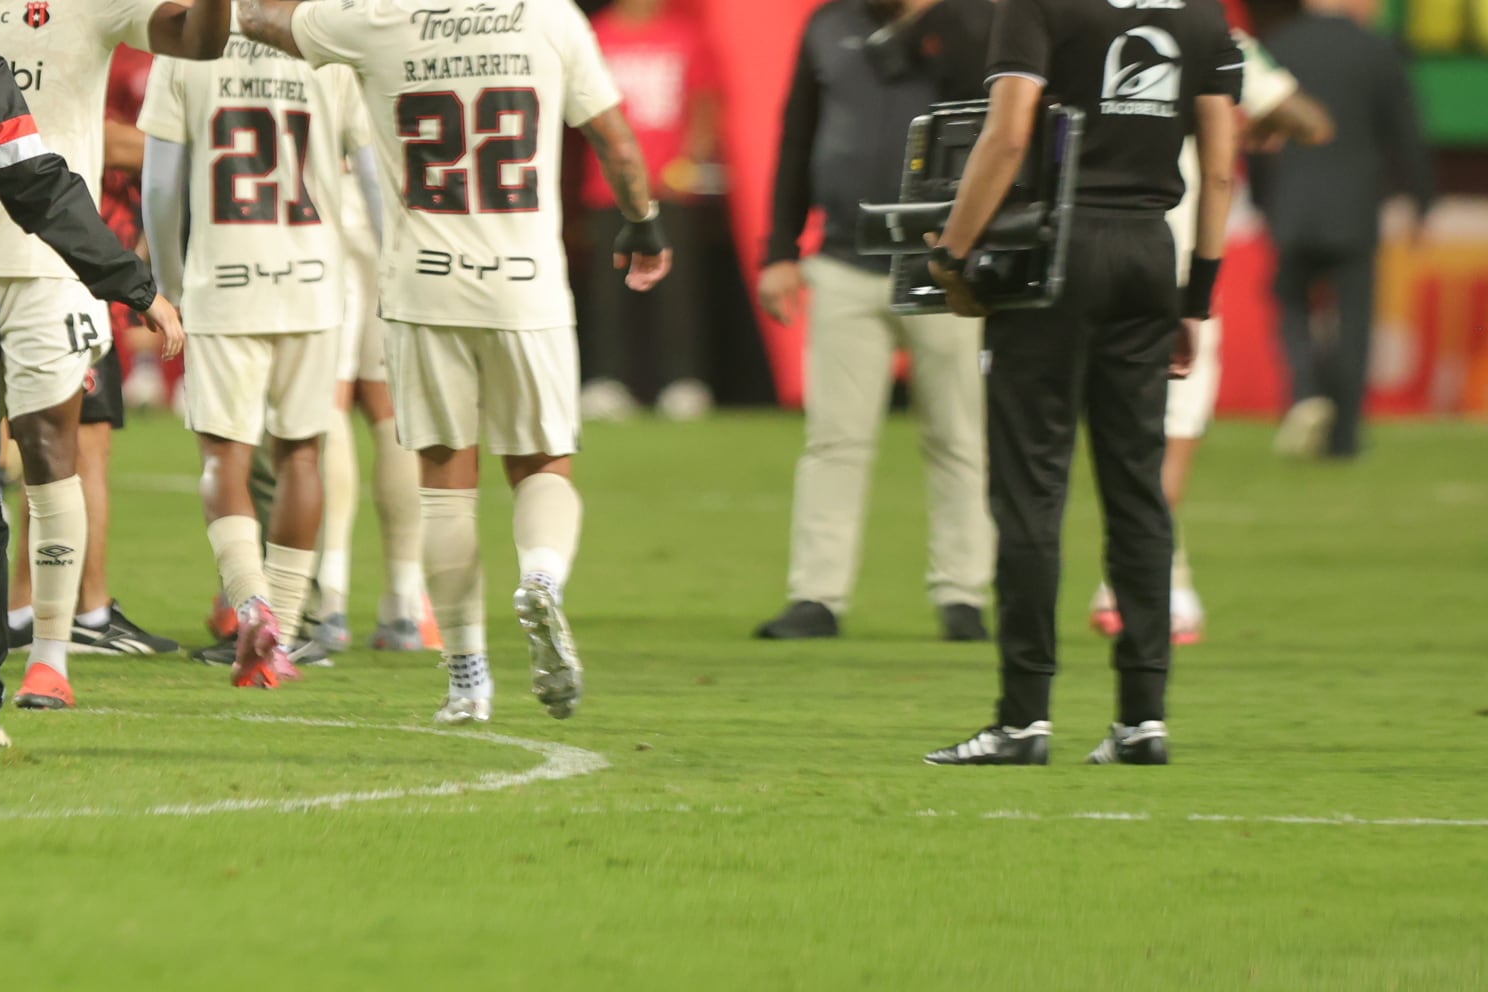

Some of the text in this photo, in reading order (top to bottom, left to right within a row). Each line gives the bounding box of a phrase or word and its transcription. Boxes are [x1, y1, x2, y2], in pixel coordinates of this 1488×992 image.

[411, 1, 525, 43] Tropical
[404, 55, 532, 82] R.MATARRITA
[218, 77, 308, 103] K.MICHEL
[396, 86, 540, 214] 22
[209, 107, 323, 227] 21
[215, 260, 324, 288] BYD
[417, 249, 536, 281] BYD
